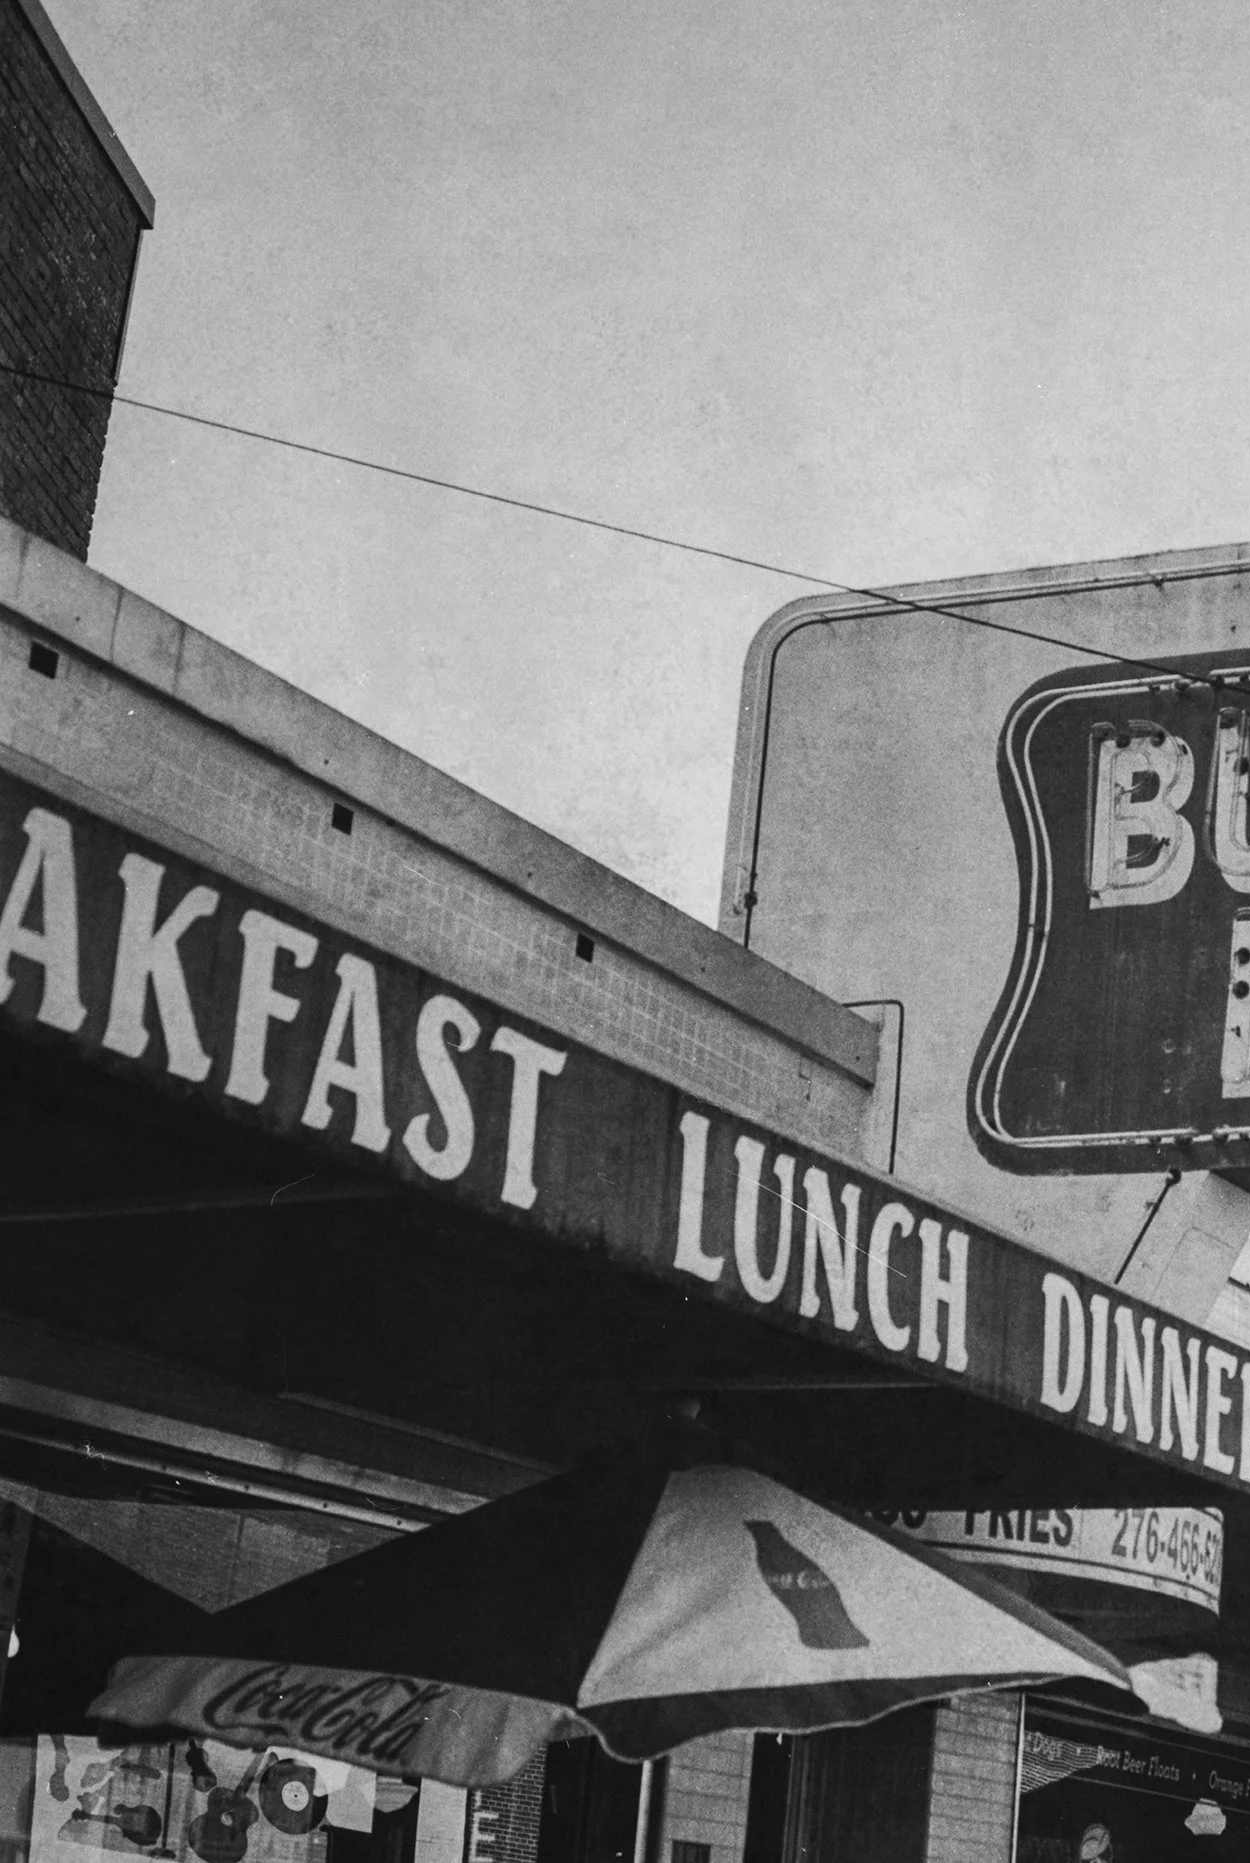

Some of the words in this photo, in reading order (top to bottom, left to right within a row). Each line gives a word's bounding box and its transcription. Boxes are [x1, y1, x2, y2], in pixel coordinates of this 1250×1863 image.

[673, 1110, 970, 1373] LUNCH
[1122, 1751, 1146, 1775] Beer
[1147, 1755, 1180, 1782] Floats
[1208, 1769, 1244, 1799] Orange
